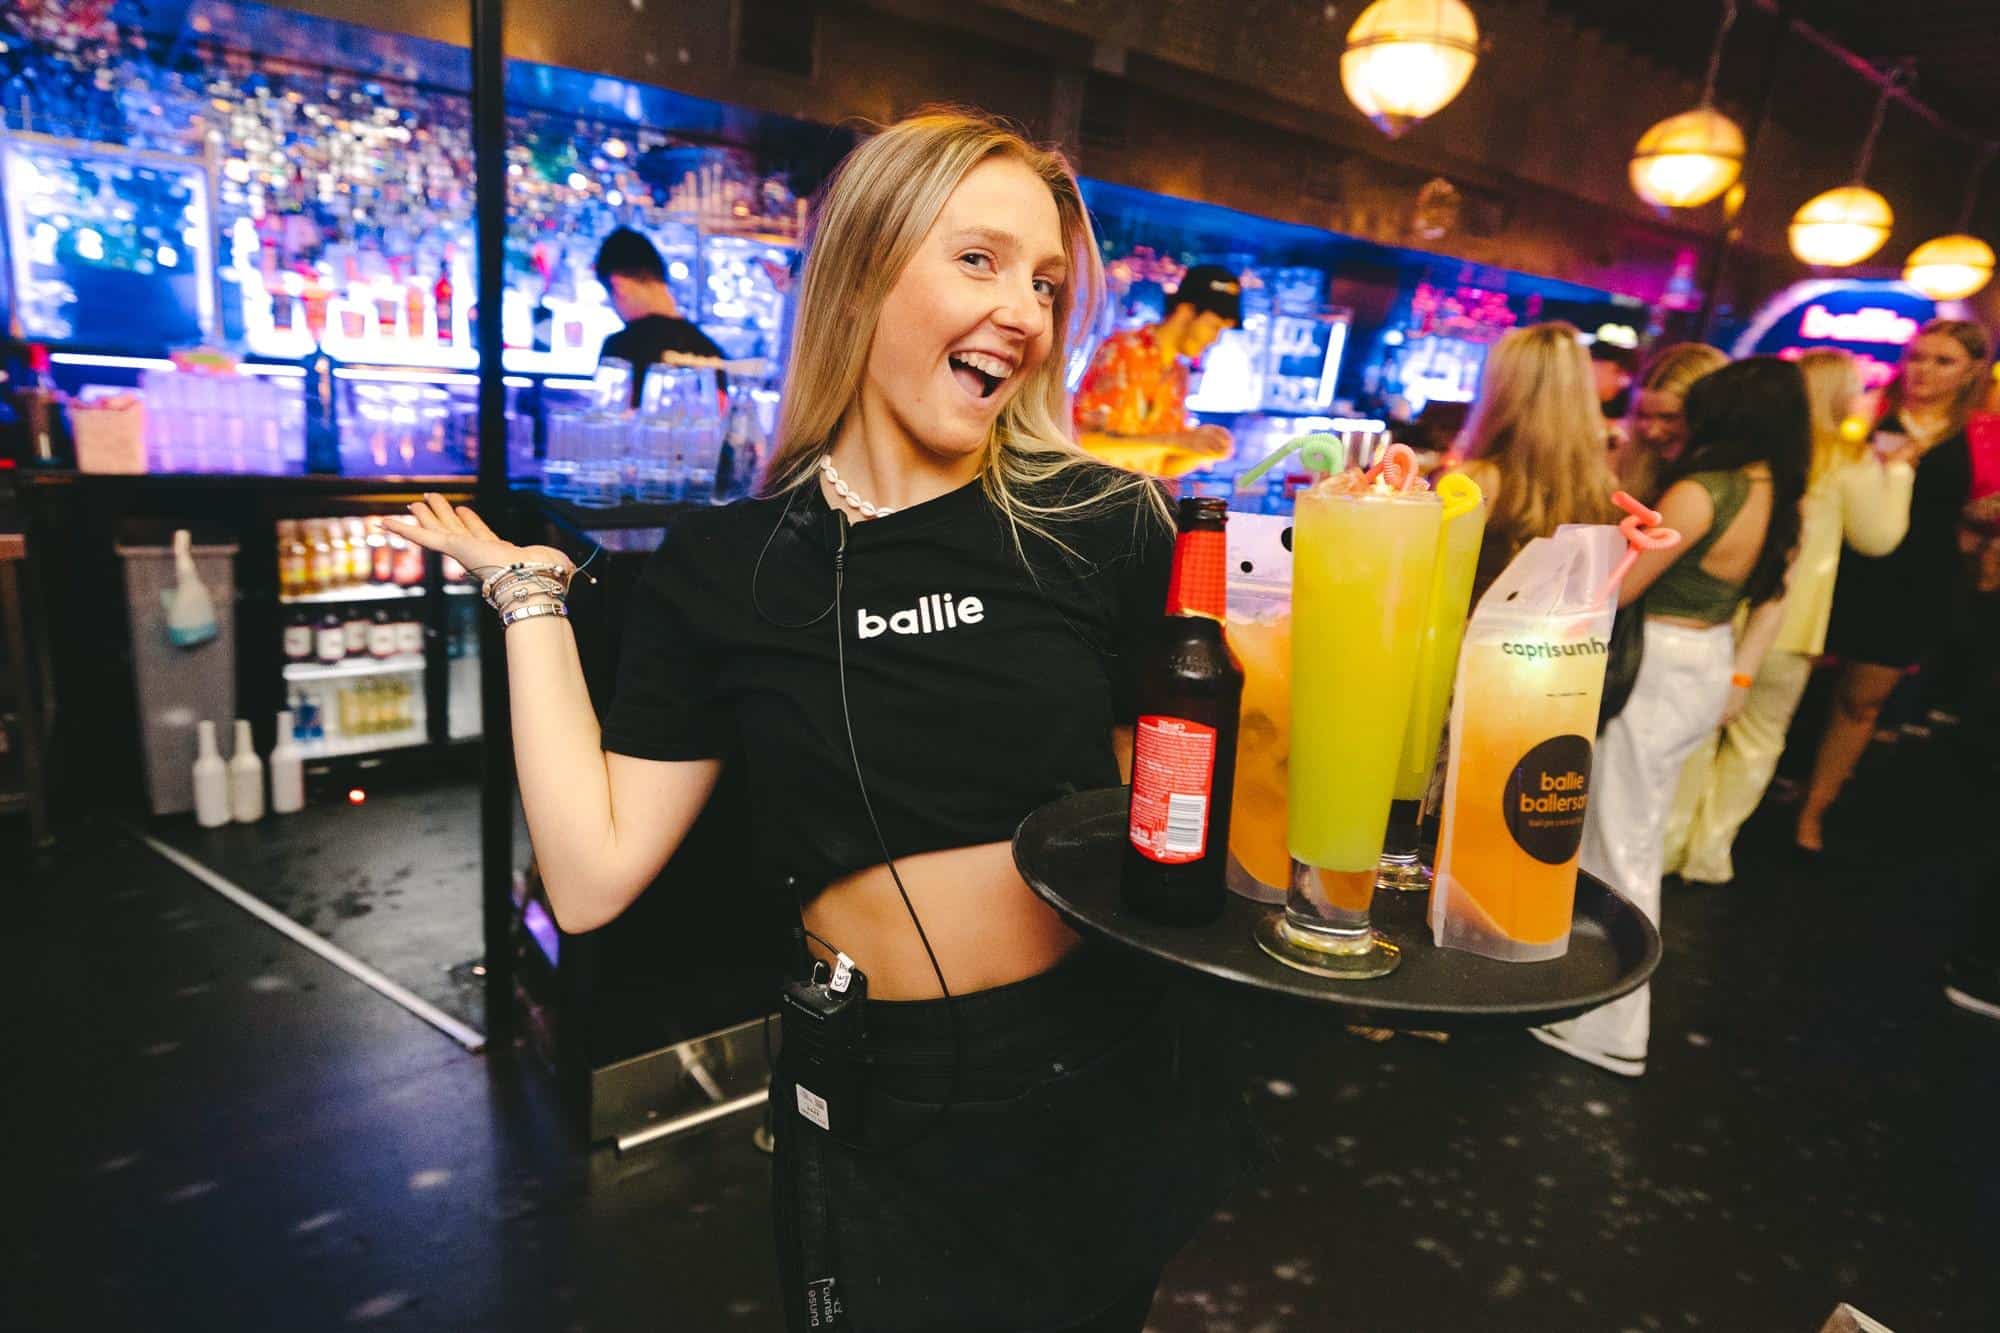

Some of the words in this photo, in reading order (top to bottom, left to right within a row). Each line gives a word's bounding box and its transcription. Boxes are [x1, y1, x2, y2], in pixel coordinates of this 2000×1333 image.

[857, 592, 985, 639] ballie
[1501, 637, 1610, 661] caprisunh
[1541, 771, 1584, 791] ballie
